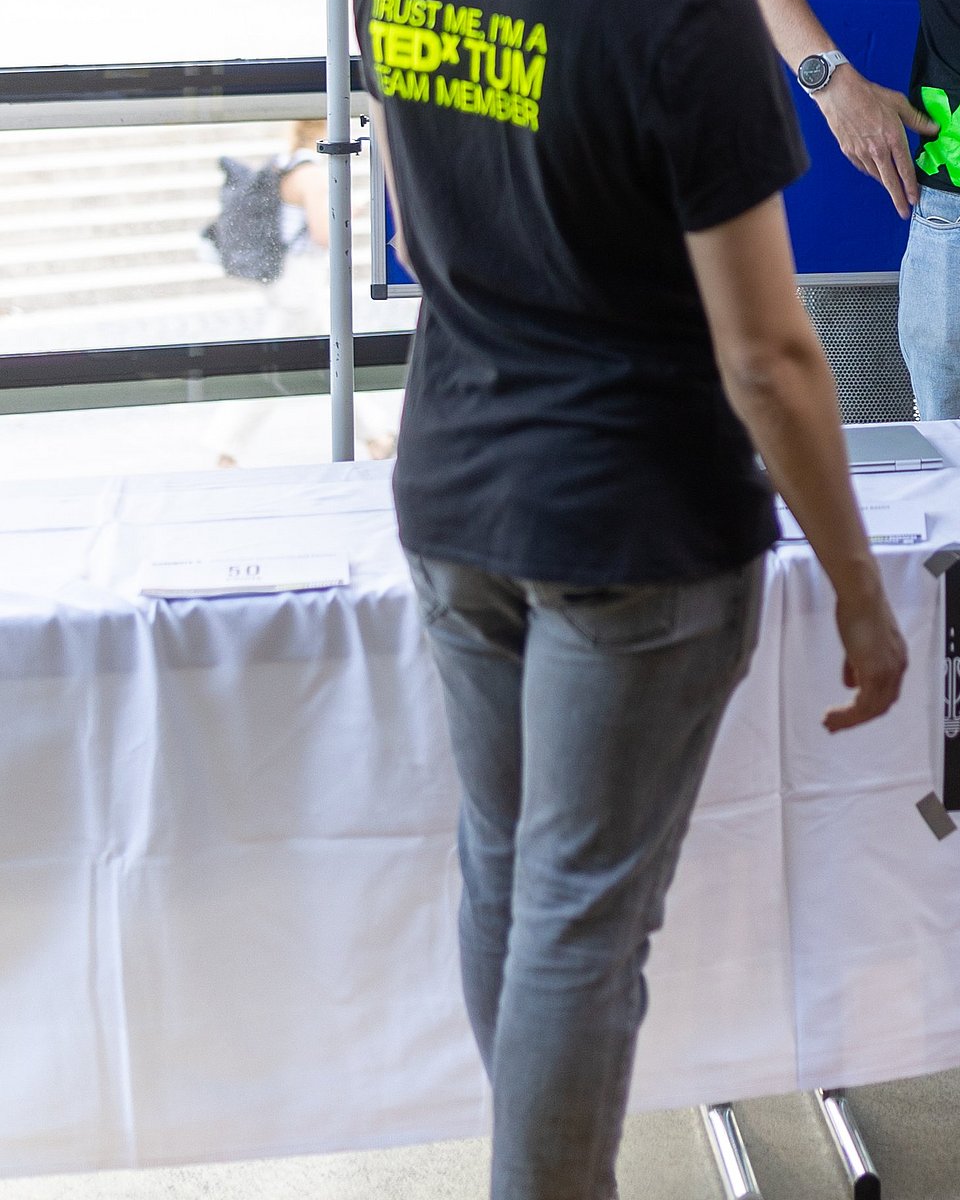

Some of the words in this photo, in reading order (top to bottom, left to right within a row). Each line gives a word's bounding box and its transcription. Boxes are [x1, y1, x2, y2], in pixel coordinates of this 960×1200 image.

[488, 12, 525, 48] I'M
[525, 22, 548, 55] A
[374, 63, 430, 103] TEAM
[435, 75, 539, 132] MEMBER
[227, 565, 260, 577] 50
